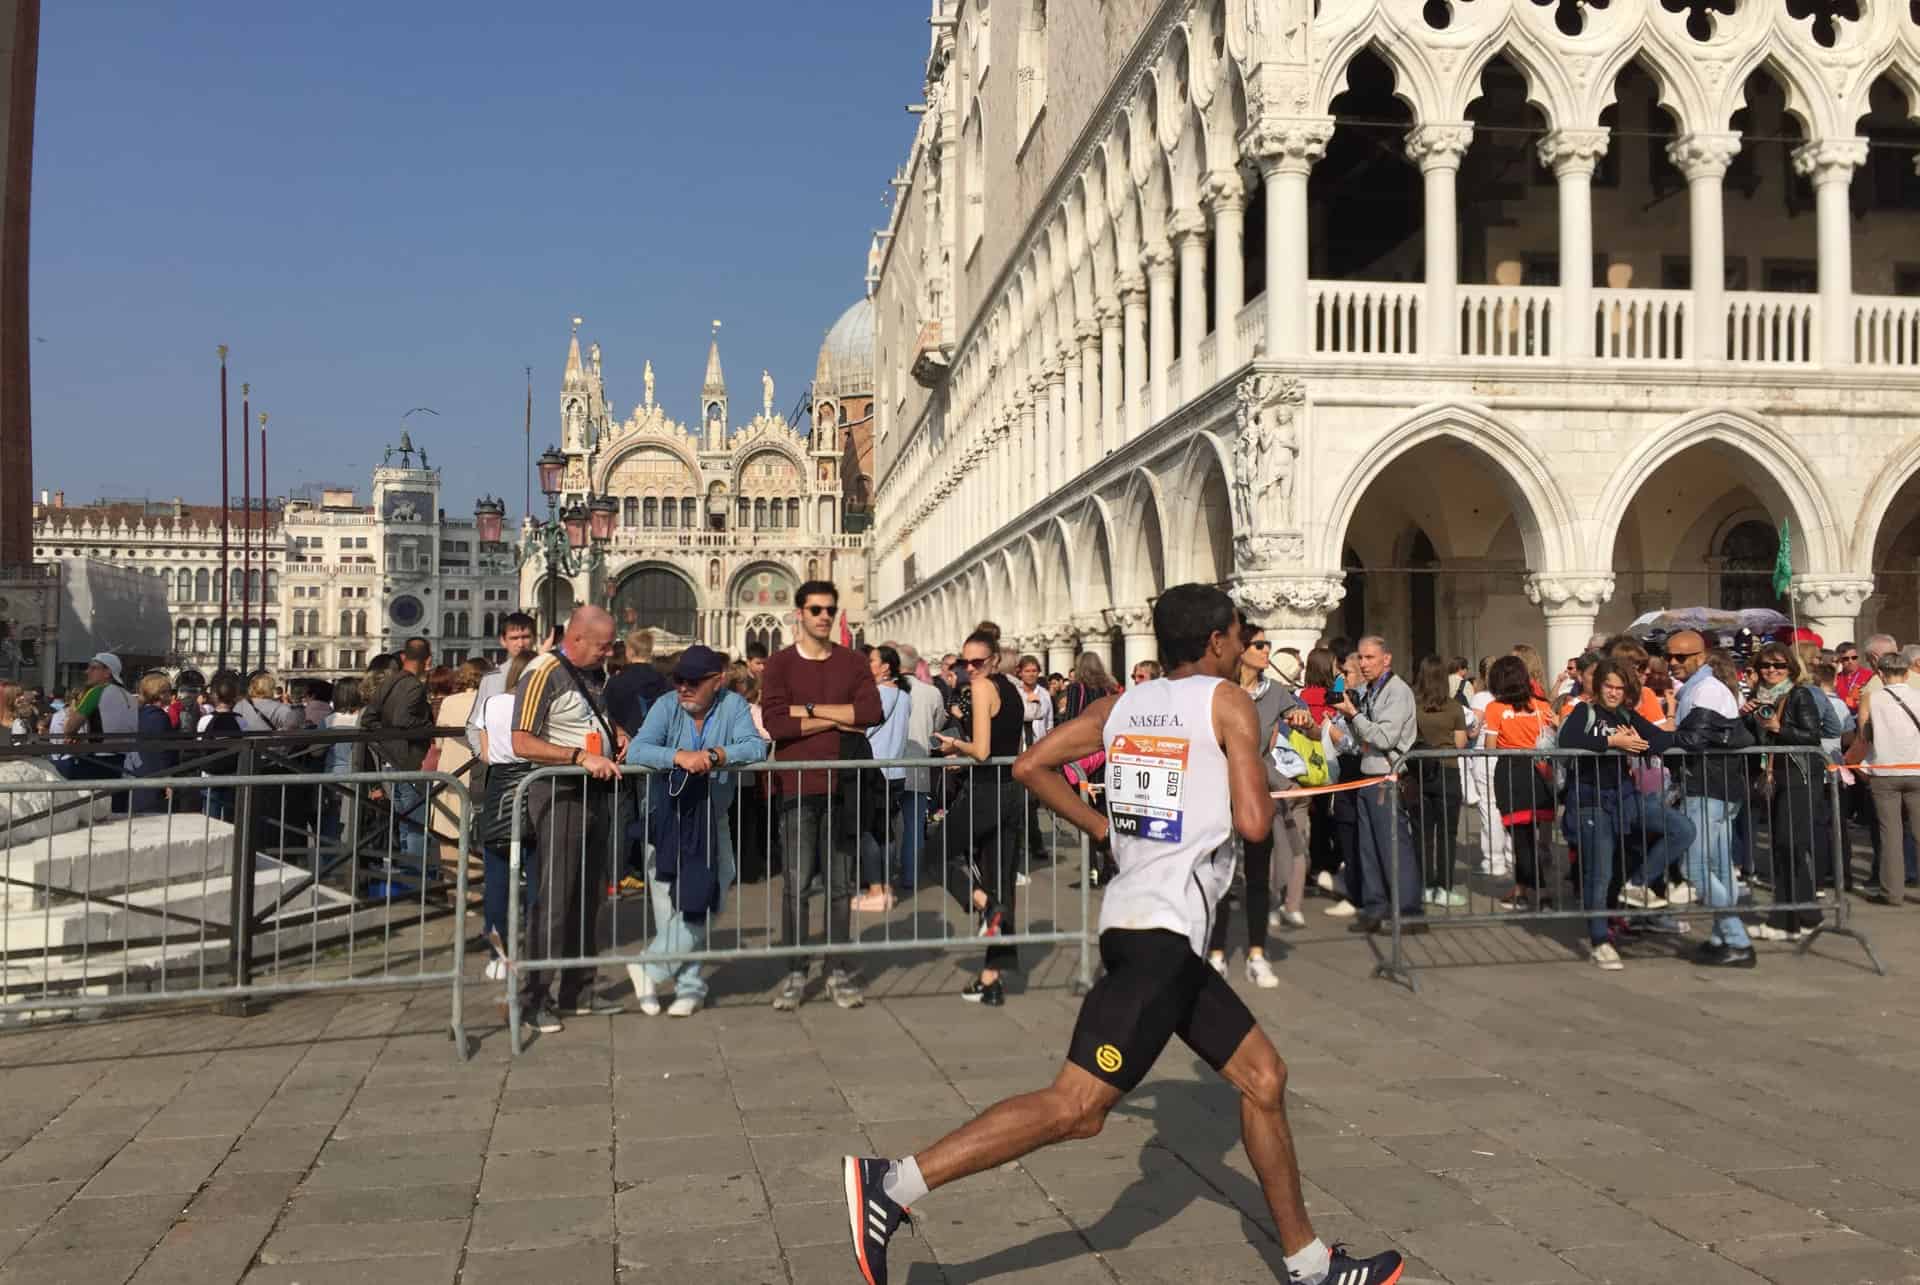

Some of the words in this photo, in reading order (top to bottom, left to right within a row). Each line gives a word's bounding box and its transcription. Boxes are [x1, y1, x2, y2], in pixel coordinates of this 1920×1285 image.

[1129, 714, 1168, 728] NASEF
[1169, 713, 1184, 727] A.
[1136, 770, 1150, 790] 10
